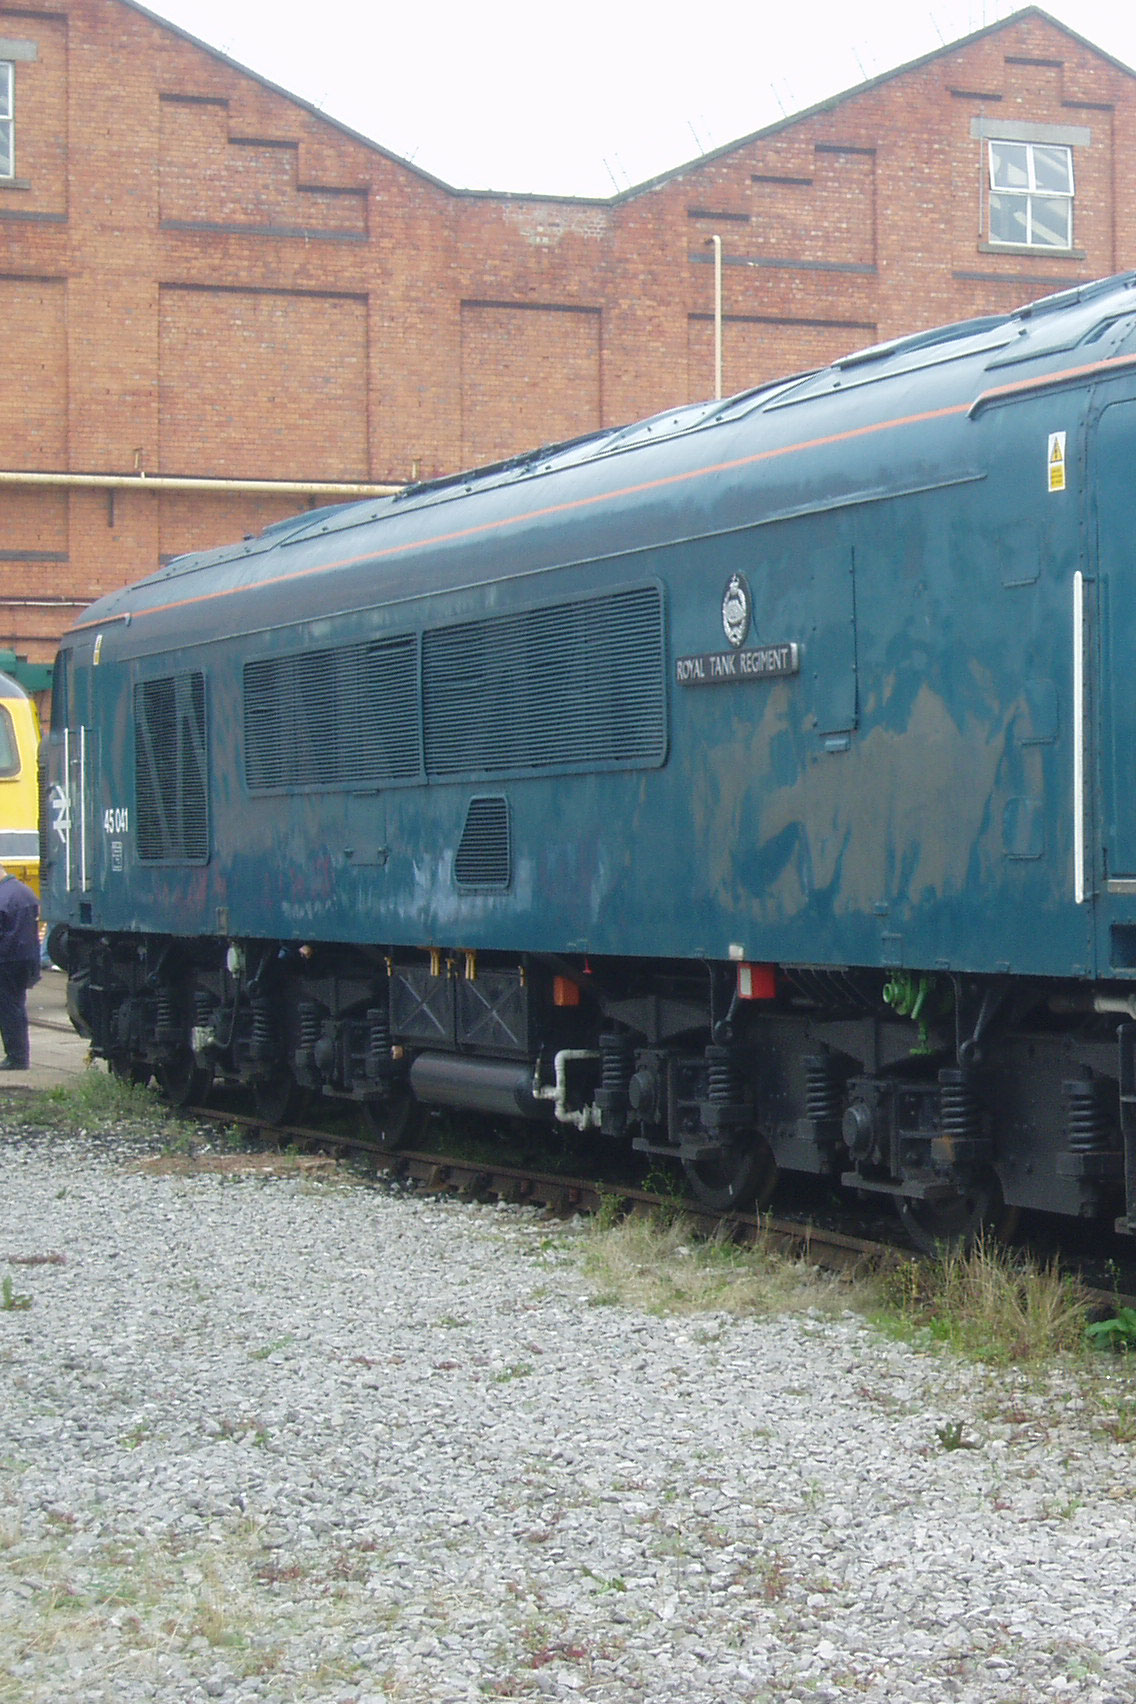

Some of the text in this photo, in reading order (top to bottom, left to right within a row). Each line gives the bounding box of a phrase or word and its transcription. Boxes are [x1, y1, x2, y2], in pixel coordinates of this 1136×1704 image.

[676, 648, 788, 680] ROYAL TANK REGIMENT
